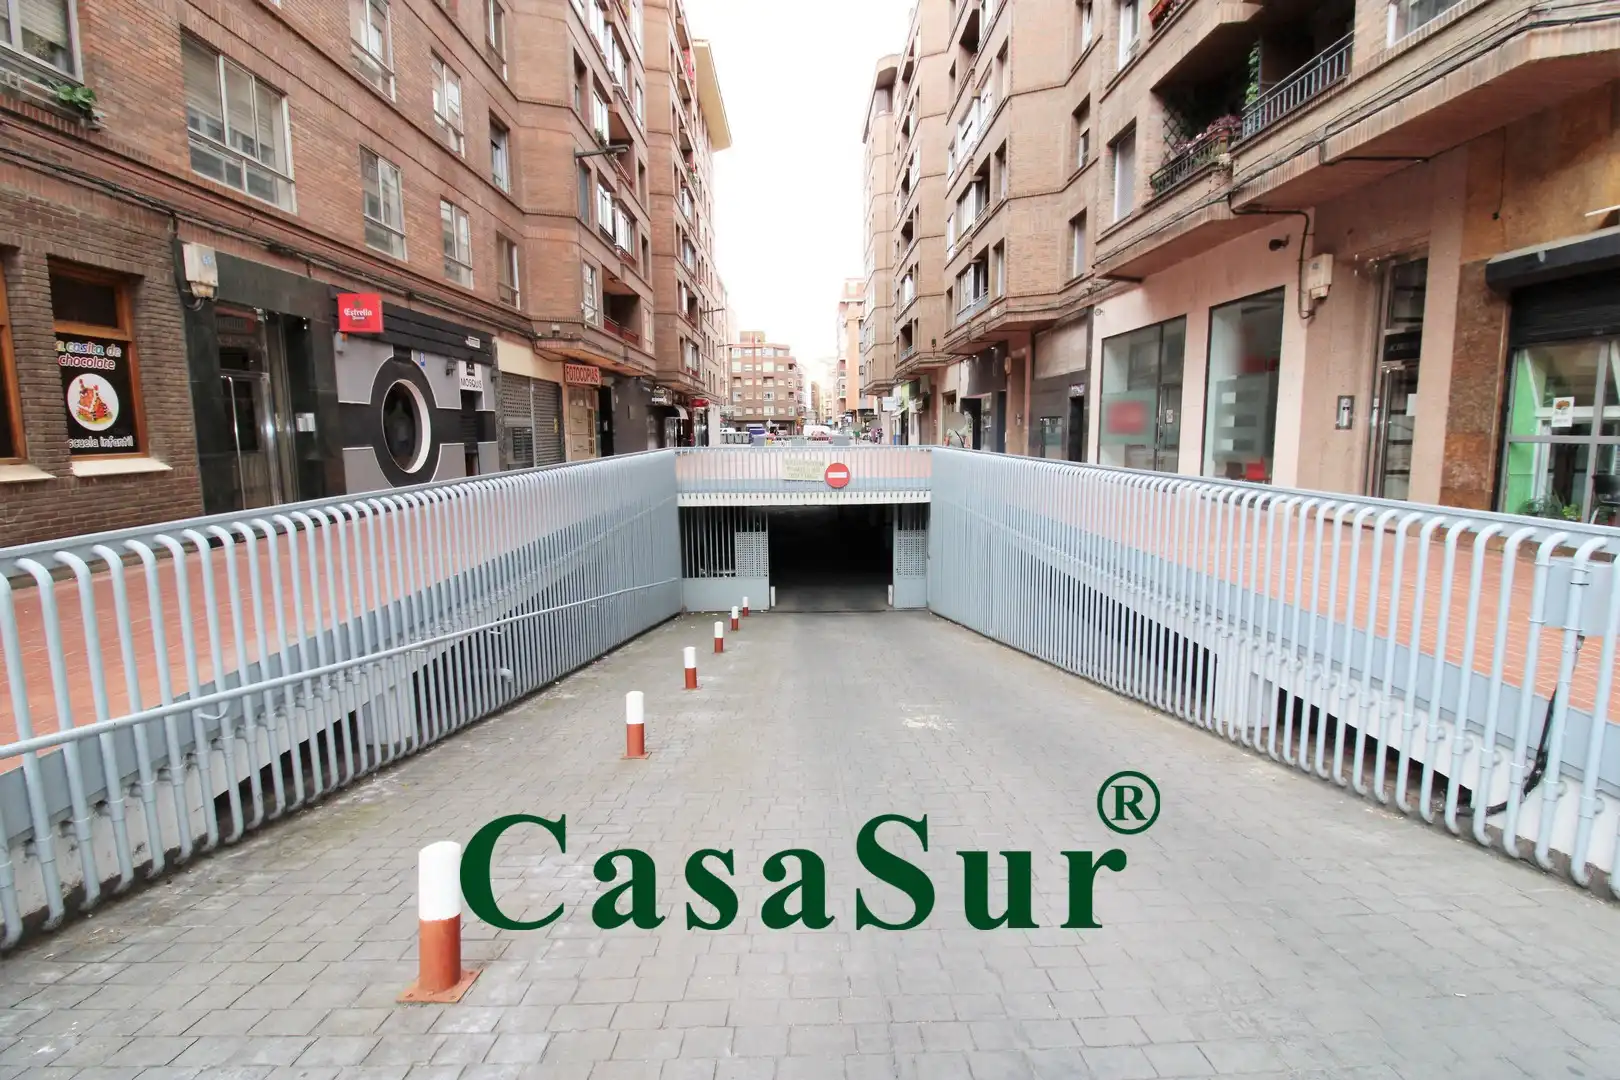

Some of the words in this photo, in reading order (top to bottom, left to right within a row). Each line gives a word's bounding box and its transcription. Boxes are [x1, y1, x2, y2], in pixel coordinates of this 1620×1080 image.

[343, 307, 373, 317] Estrella
[66, 341, 104, 355] casita
[106, 344, 121, 357] de
[58, 353, 116, 370] chocolate
[566, 365, 599, 384] FOTOCOPIAS
[460, 377, 483, 389] MOSQUIS
[68, 436, 99, 448] scuela
[100, 435, 133, 447] infantil
